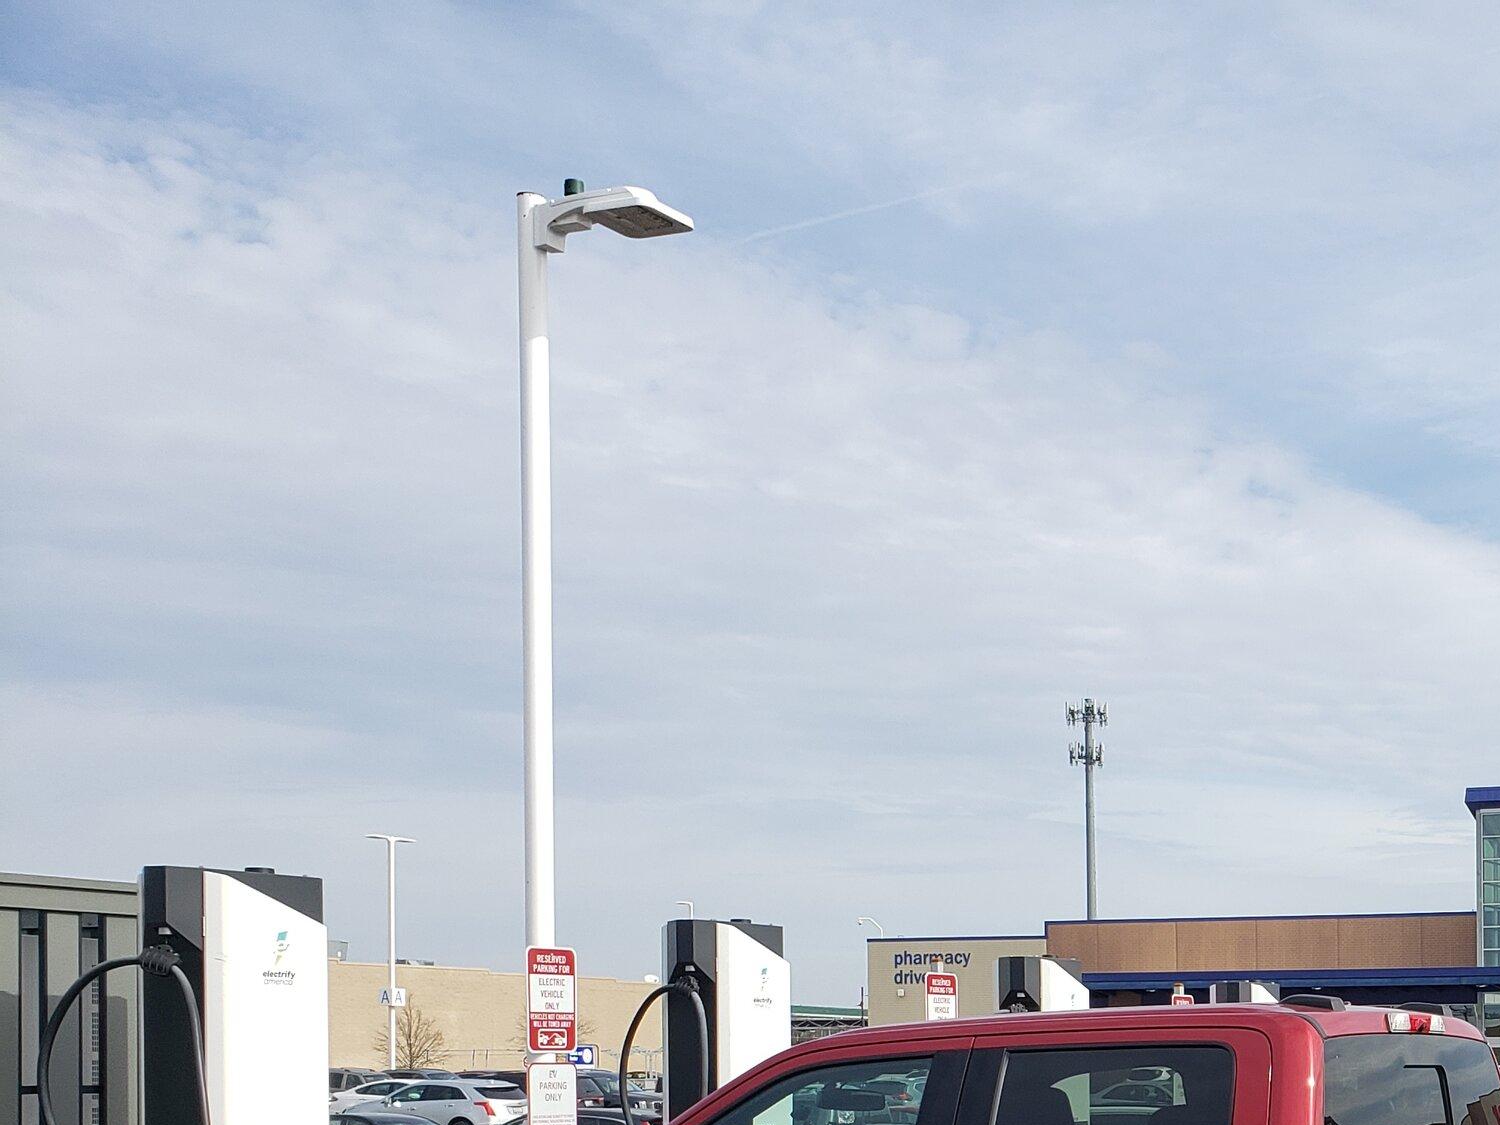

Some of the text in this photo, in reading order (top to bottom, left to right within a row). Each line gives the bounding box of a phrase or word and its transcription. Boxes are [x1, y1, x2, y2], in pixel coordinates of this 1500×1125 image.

[536, 954, 567, 964] RESERVED
[533, 964, 570, 974] PARKING FOR
[262, 970, 296, 980] electrify
[538, 978, 566, 987] ELECTRIC
[381, 990, 390, 1004] A
[395, 990, 403, 1004] A
[540, 990, 564, 999] VEHICLE
[544, 1002, 560, 1010] ONLY
[548, 1070, 558, 1079] EV
[539, 1081, 568, 1090] PARKING
[544, 1093, 562, 1102] ONLY
